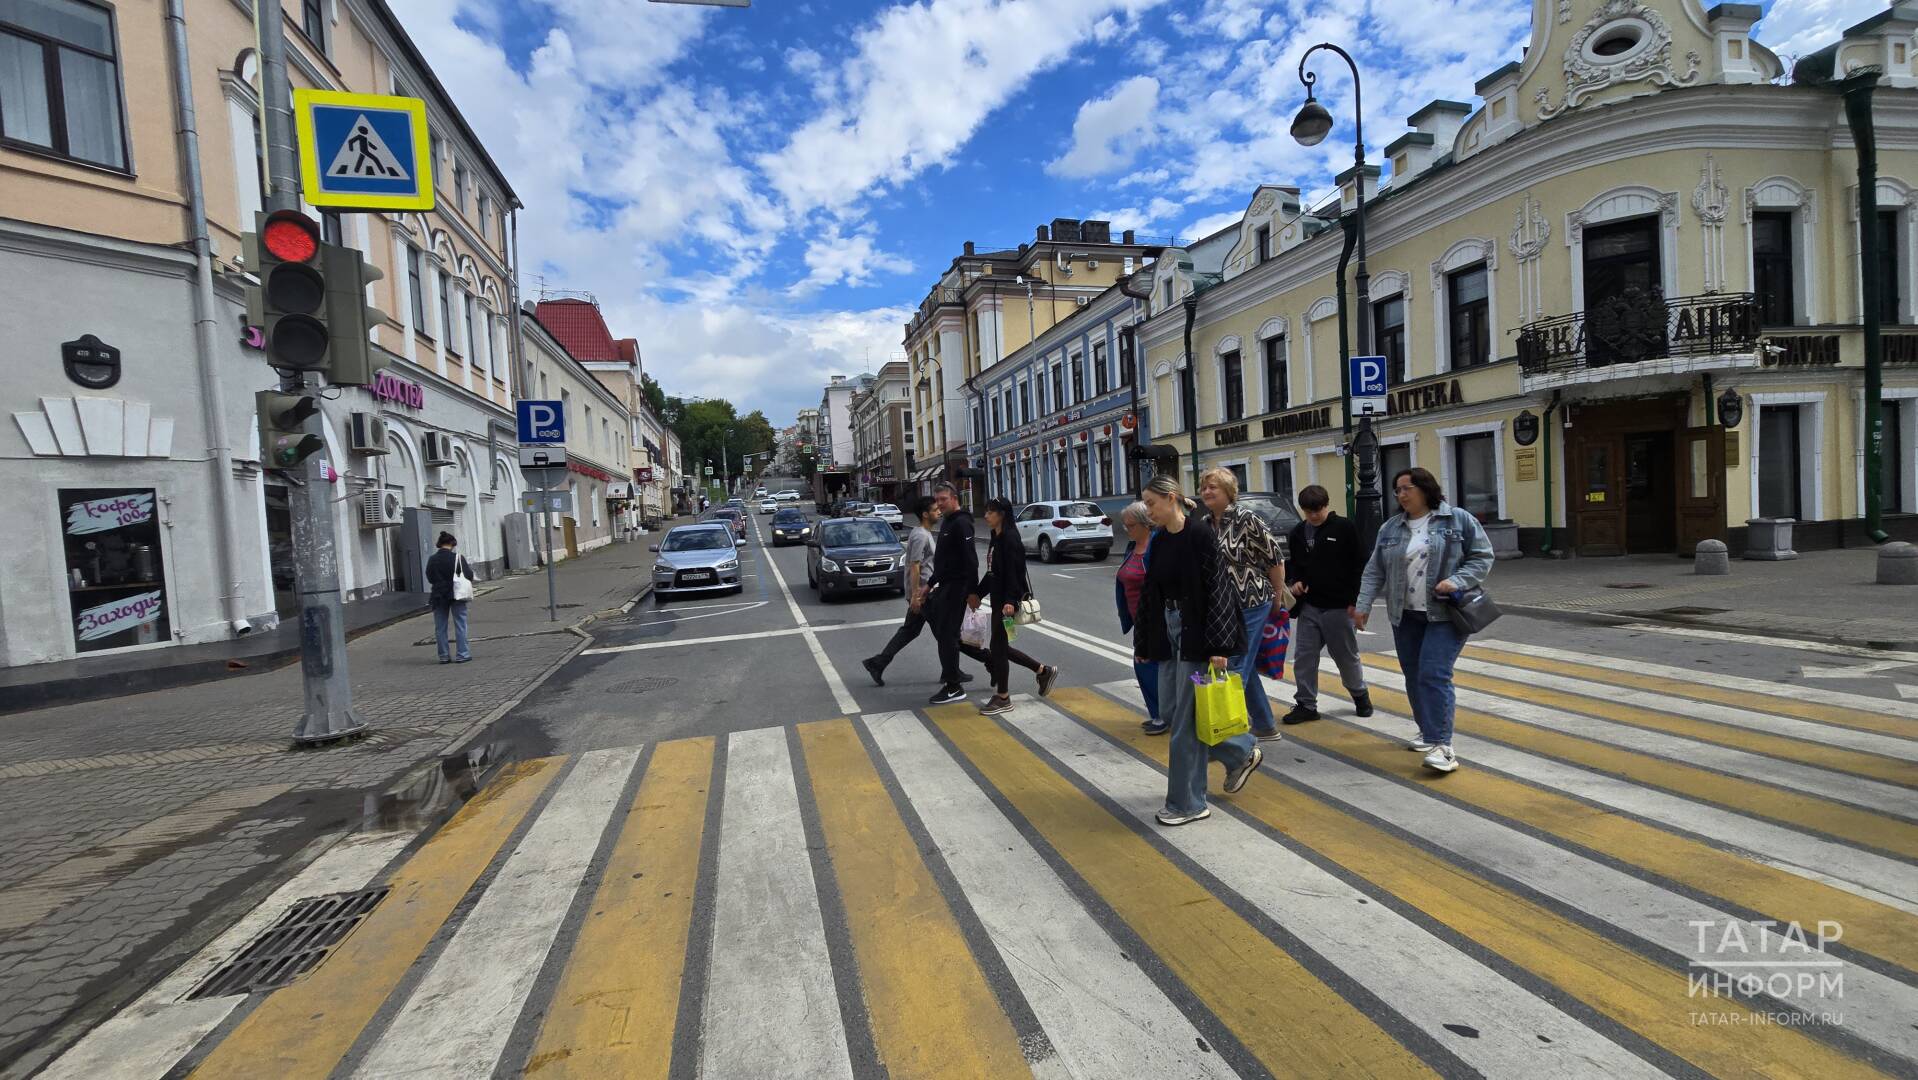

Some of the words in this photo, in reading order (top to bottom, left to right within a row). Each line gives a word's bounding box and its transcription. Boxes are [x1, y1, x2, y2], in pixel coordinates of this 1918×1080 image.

[1360, 362, 1380, 392] P
[1387, 379, 1464, 416] АПТЕКА
[529, 405, 555, 438] P
[82, 499, 140, 518] Кофе
[78, 597, 159, 630] Заходи
